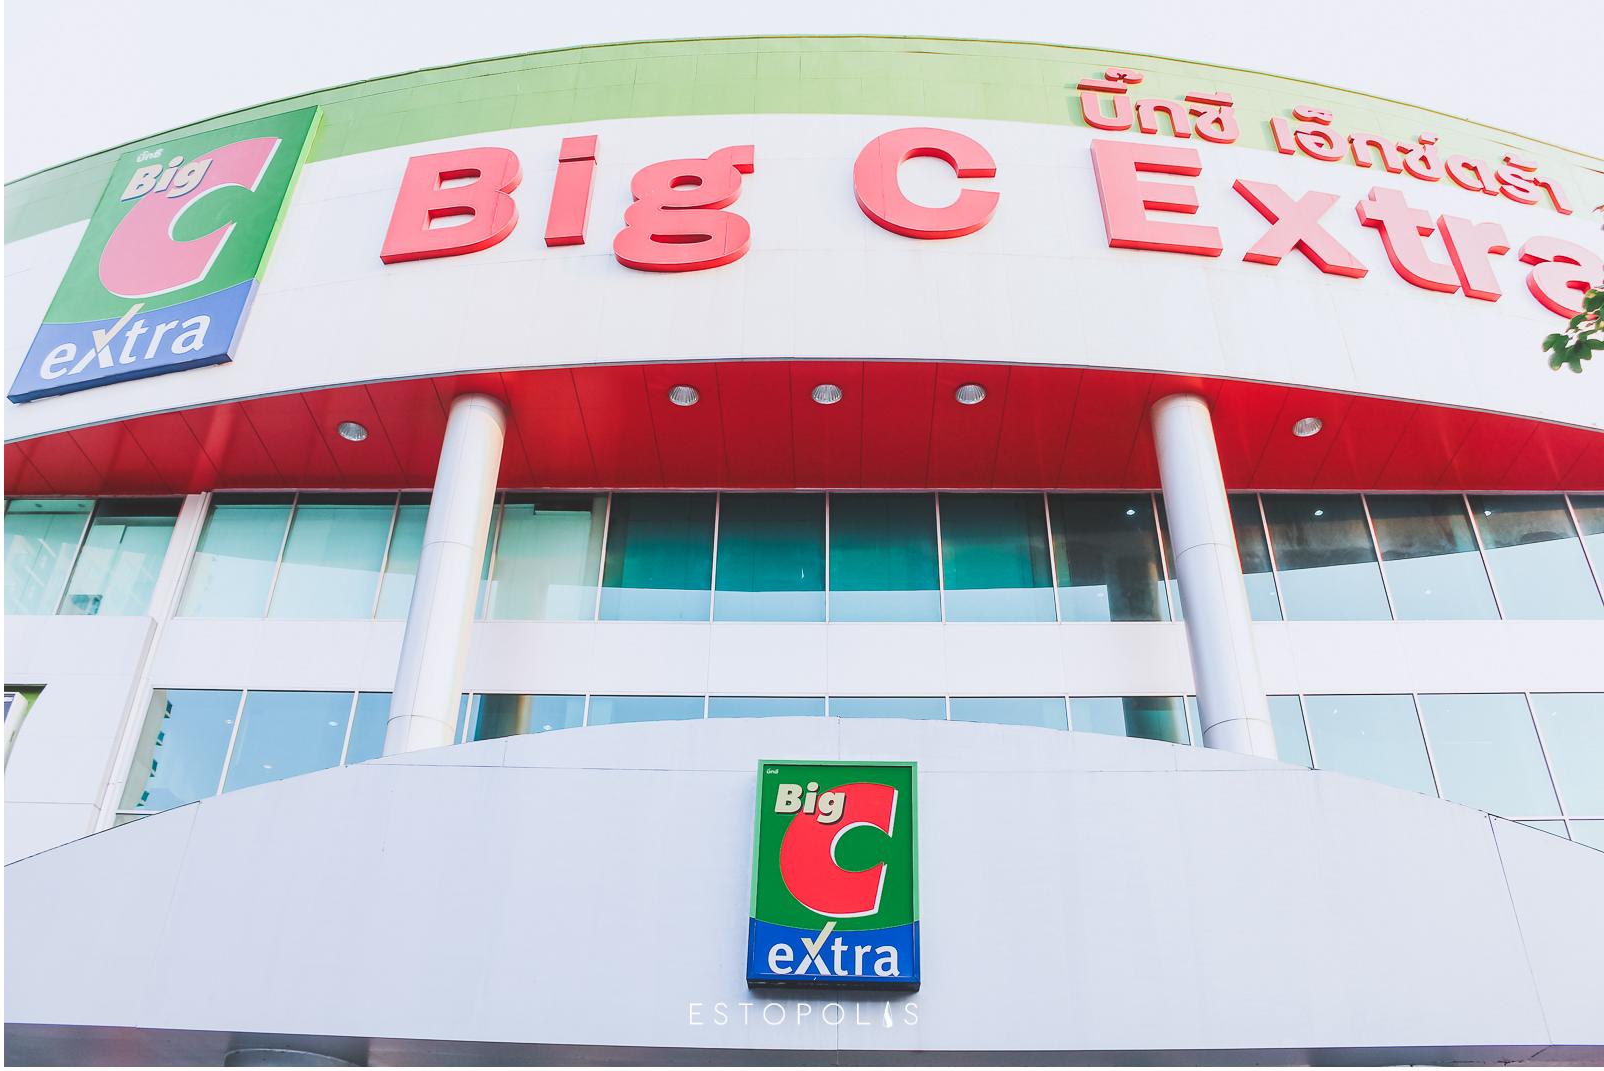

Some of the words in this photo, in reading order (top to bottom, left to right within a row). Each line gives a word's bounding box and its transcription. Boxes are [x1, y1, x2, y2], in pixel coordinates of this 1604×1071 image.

[1077, 68, 1240, 143] บิ๊กซี
[99, 136, 282, 298] C
[121, 155, 213, 202] Big
[379, 135, 754, 272] Big
[854, 127, 999, 239] C
[775, 782, 846, 825] Big
[779, 781, 899, 919] C
